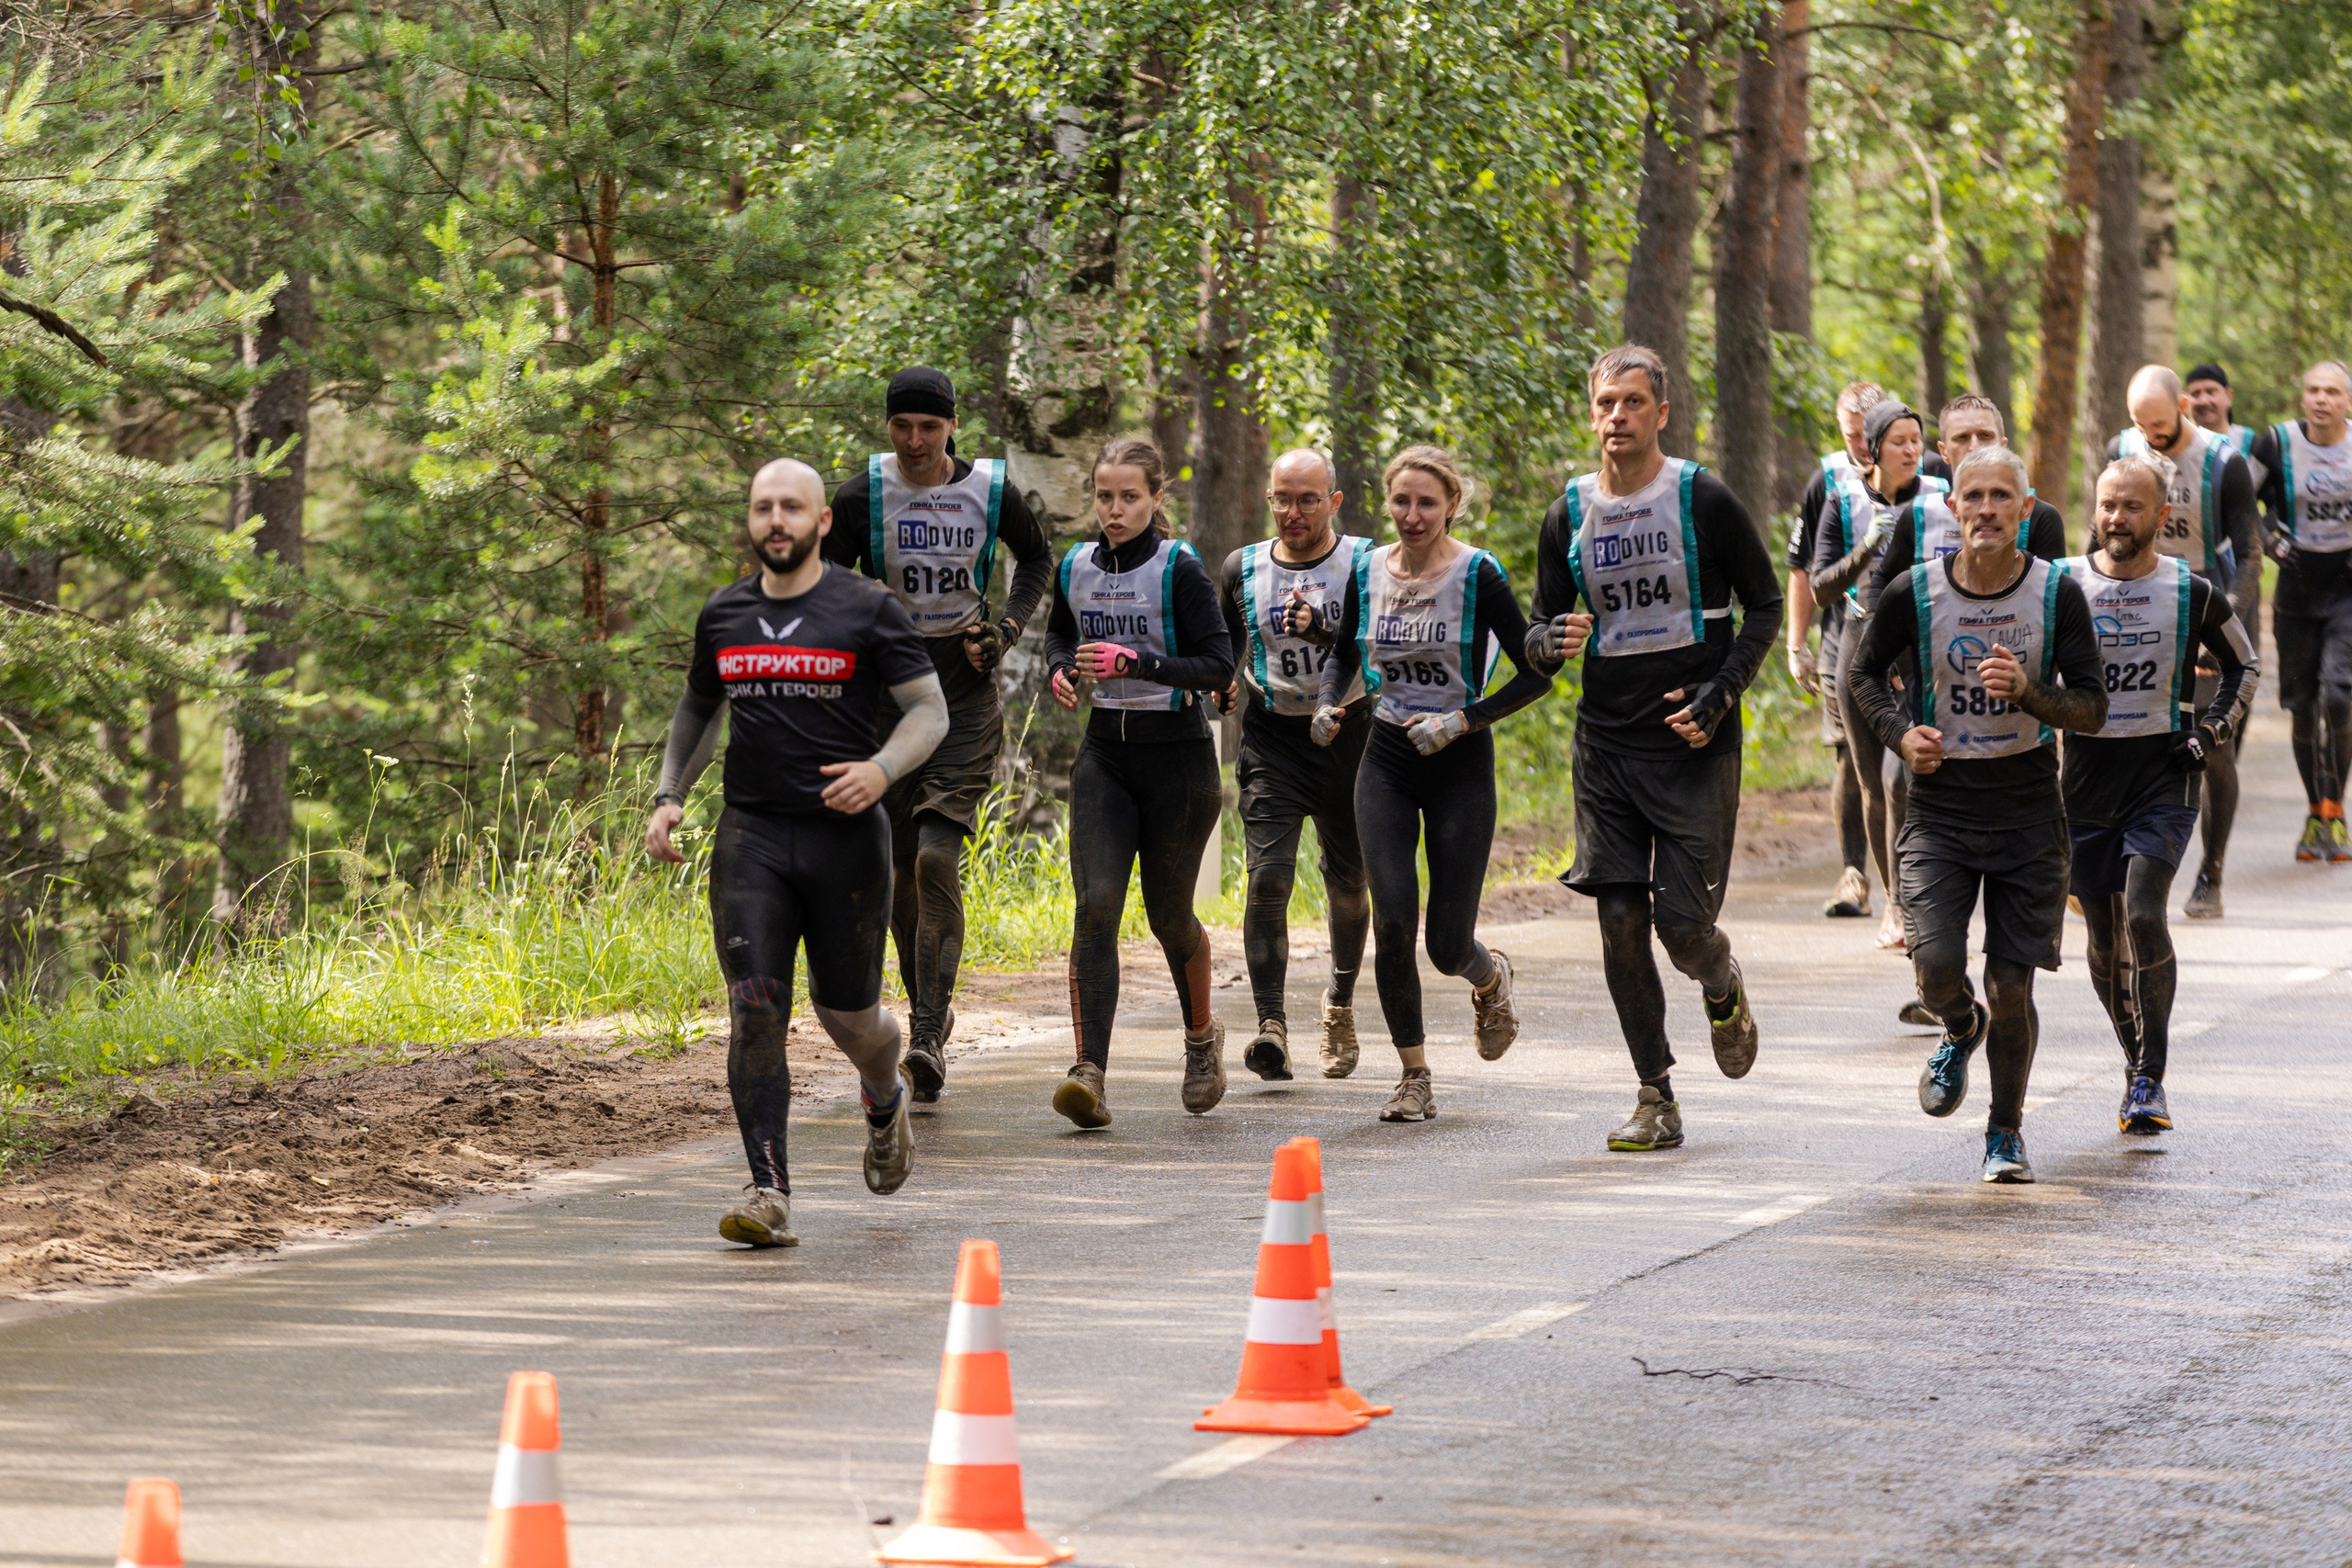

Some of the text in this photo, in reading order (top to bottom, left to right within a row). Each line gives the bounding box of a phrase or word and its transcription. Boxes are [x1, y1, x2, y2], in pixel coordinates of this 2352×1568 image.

[1602, 507, 1652, 524] ГОНКА ГЕРОЕВ
[899, 525, 974, 548] RODVIG
[1594, 530, 1668, 565] RODVIG
[902, 565, 970, 594] 6120
[1601, 574, 1672, 613] 5164
[2122, 595, 2151, 604] ГЕРОЕВ
[1081, 615, 1148, 637] RODVIG
[1959, 613, 2016, 625] ГОНКА ГЕРОЕВ
[1377, 619, 1447, 643] RODVIG
[1627, 626, 1669, 638] ГАЗПРОМБАНК
[1382, 660, 1450, 687] 5165
[2104, 660, 2157, 694] 822
[770, 682, 843, 699] ГЕРОЕВ
[1402, 703, 1443, 713] ГАЗПРОМБАНК
[2108, 712, 2148, 720] АЗПРОМБАНК
